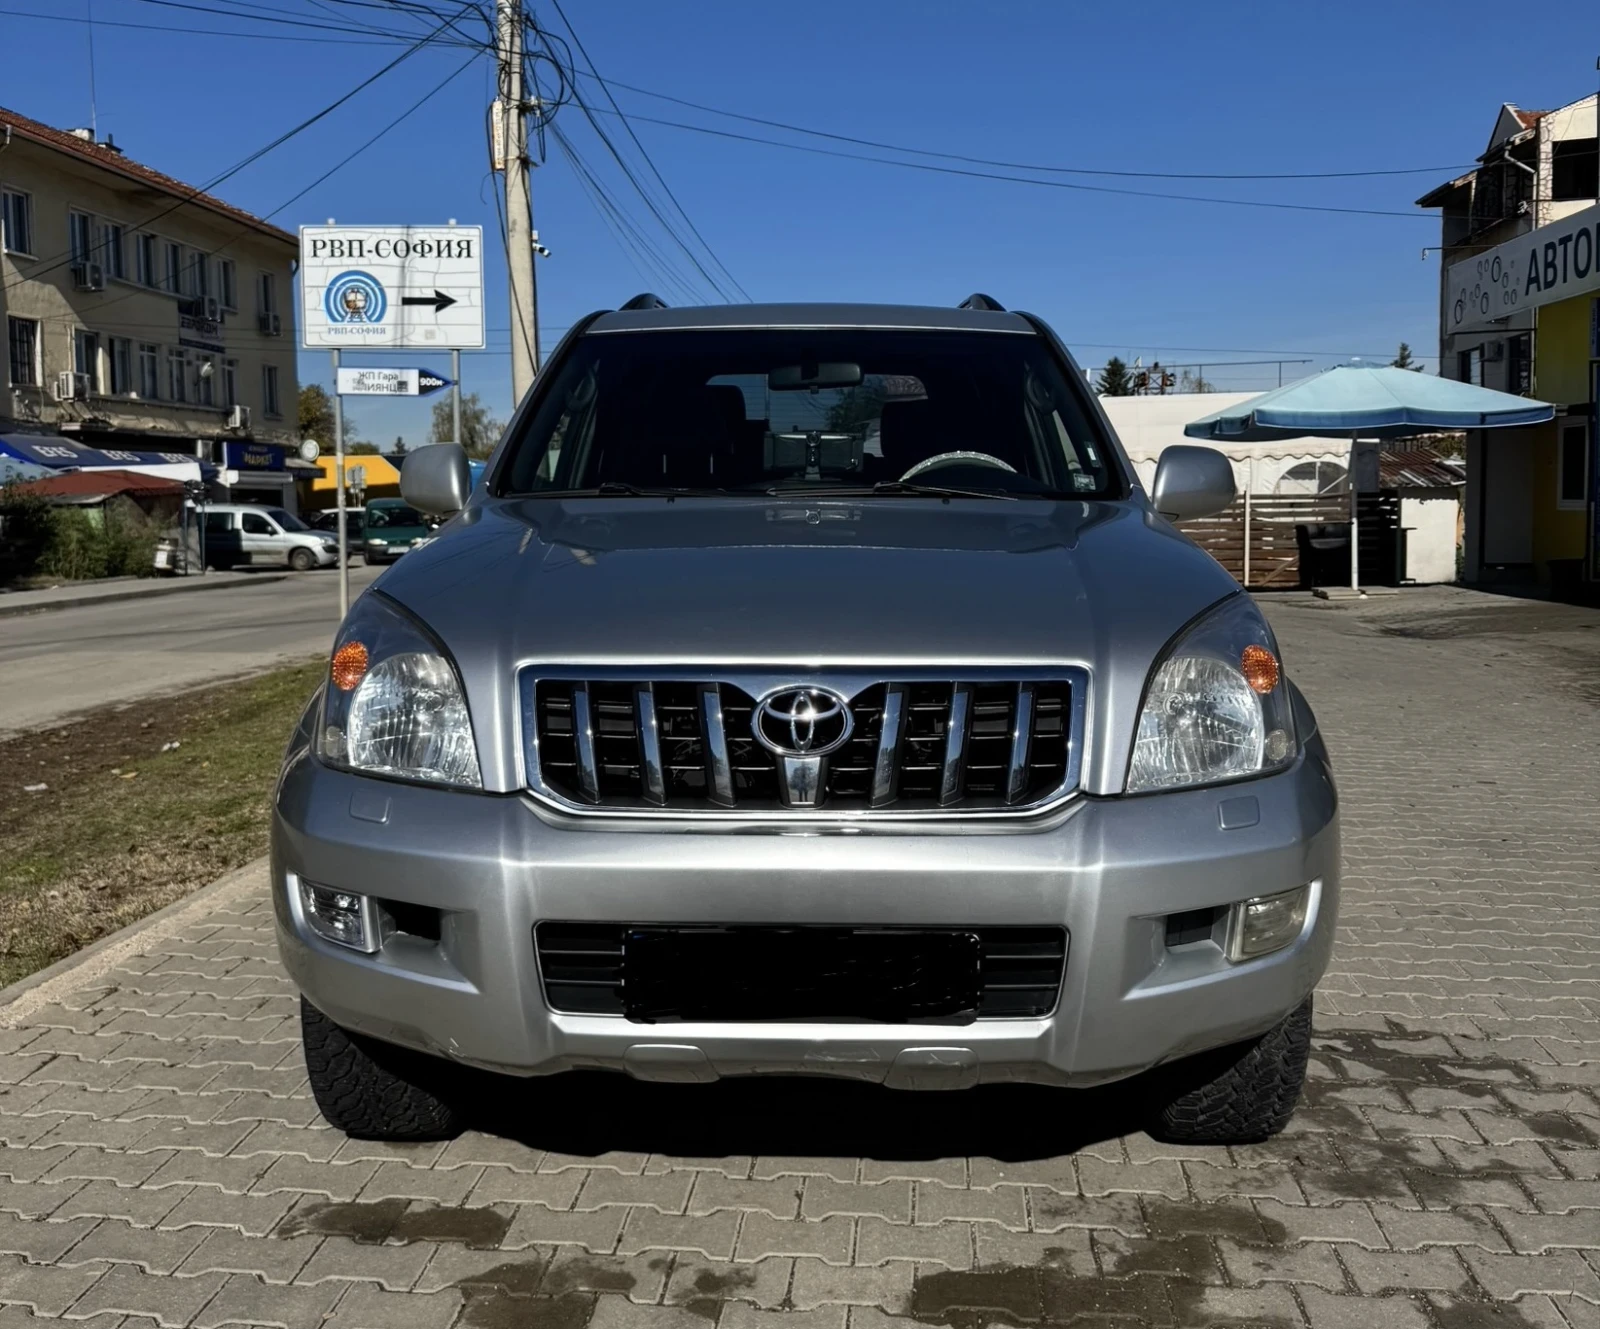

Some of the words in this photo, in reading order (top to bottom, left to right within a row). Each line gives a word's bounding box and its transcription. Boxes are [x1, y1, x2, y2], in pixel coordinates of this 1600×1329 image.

[311, 239, 474, 259] РВП-СОФИЯ
[328, 327, 386, 336] РВП-СОФИЯ
[358, 371, 375, 381] ЖП
[378, 371, 399, 383] Гара
[31, 445, 78, 458] EFES
[101, 449, 141, 462] EFES
